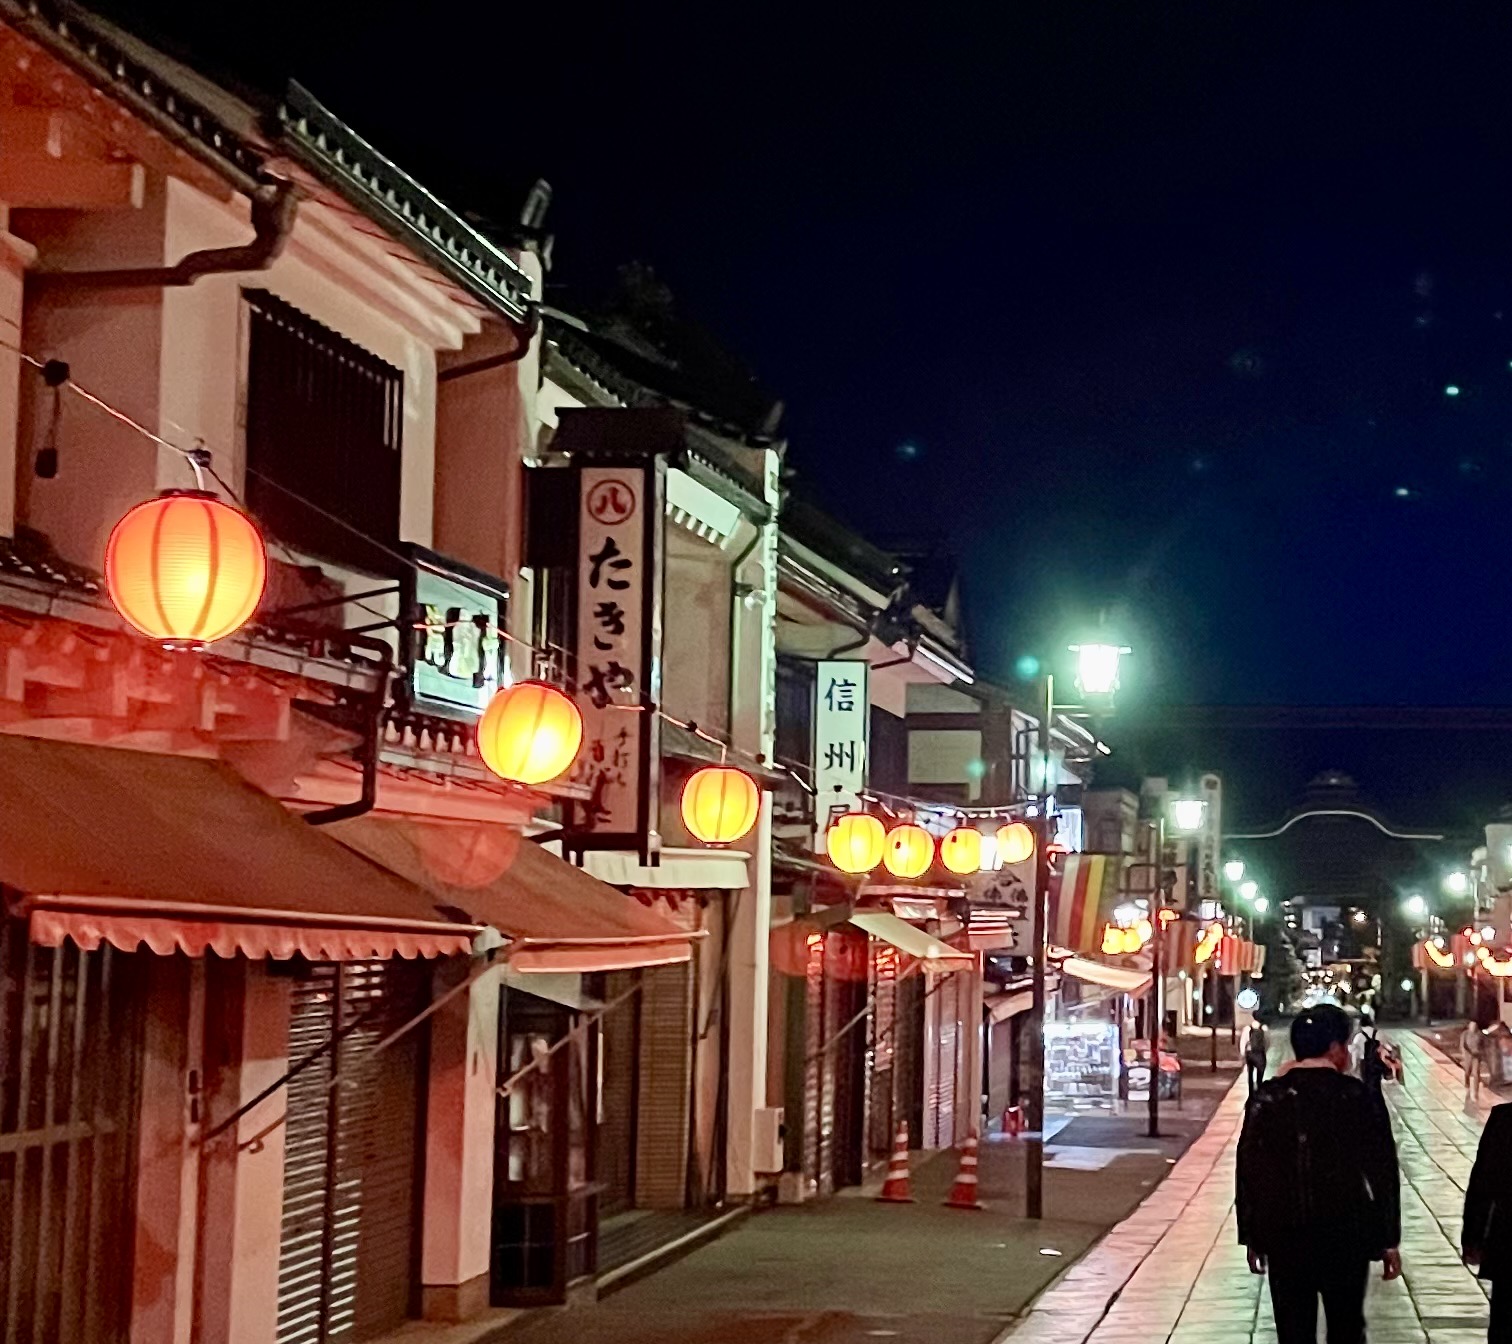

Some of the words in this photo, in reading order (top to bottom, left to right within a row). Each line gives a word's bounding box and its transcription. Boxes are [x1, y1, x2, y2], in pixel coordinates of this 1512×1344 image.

[582, 536, 635, 709] たきや
[824, 677, 857, 834] 信州
